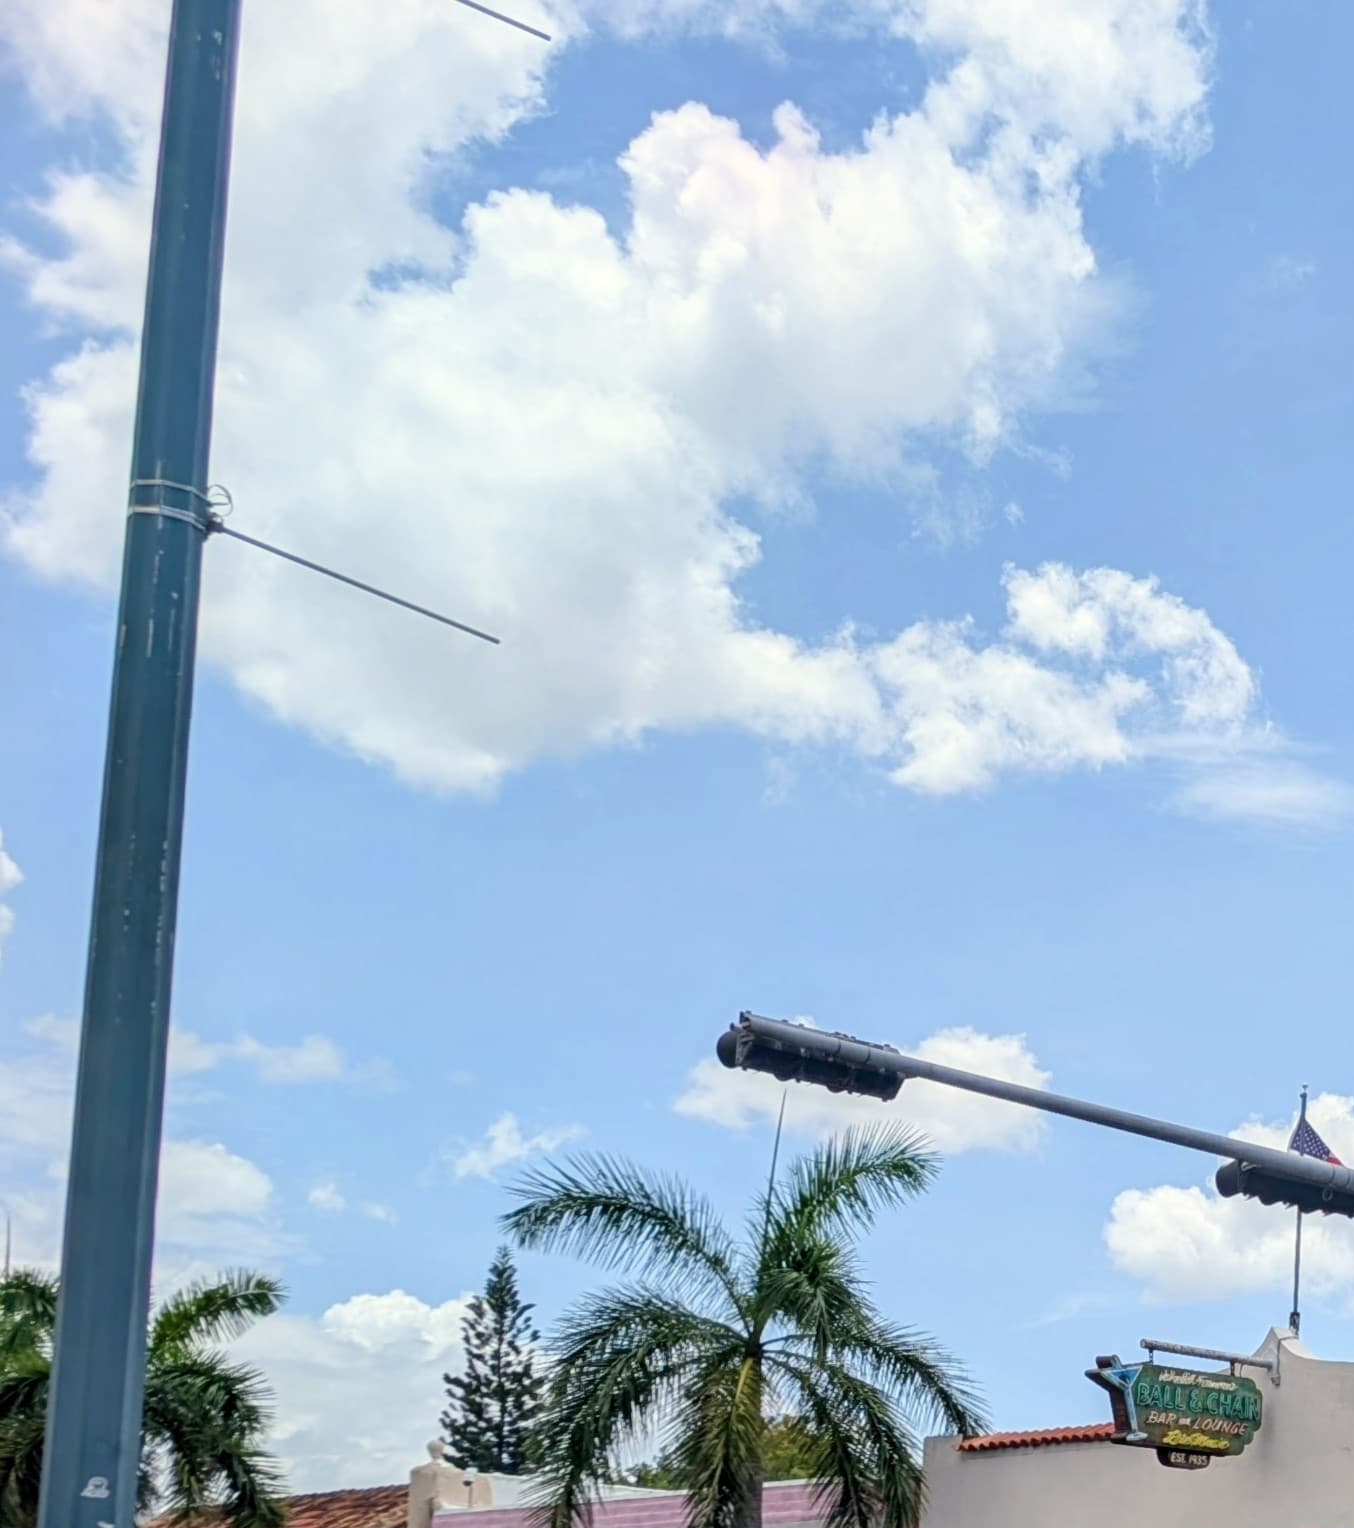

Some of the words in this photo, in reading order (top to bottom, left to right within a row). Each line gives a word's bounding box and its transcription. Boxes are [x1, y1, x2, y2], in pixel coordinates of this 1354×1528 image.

[1136, 1382, 1186, 1412] BALL
[1189, 1391, 1203, 1413] &
[1207, 1392, 1261, 1422] CHAIN
[1146, 1411, 1176, 1426] BAR
[1193, 1416, 1248, 1436] LOUNGE
